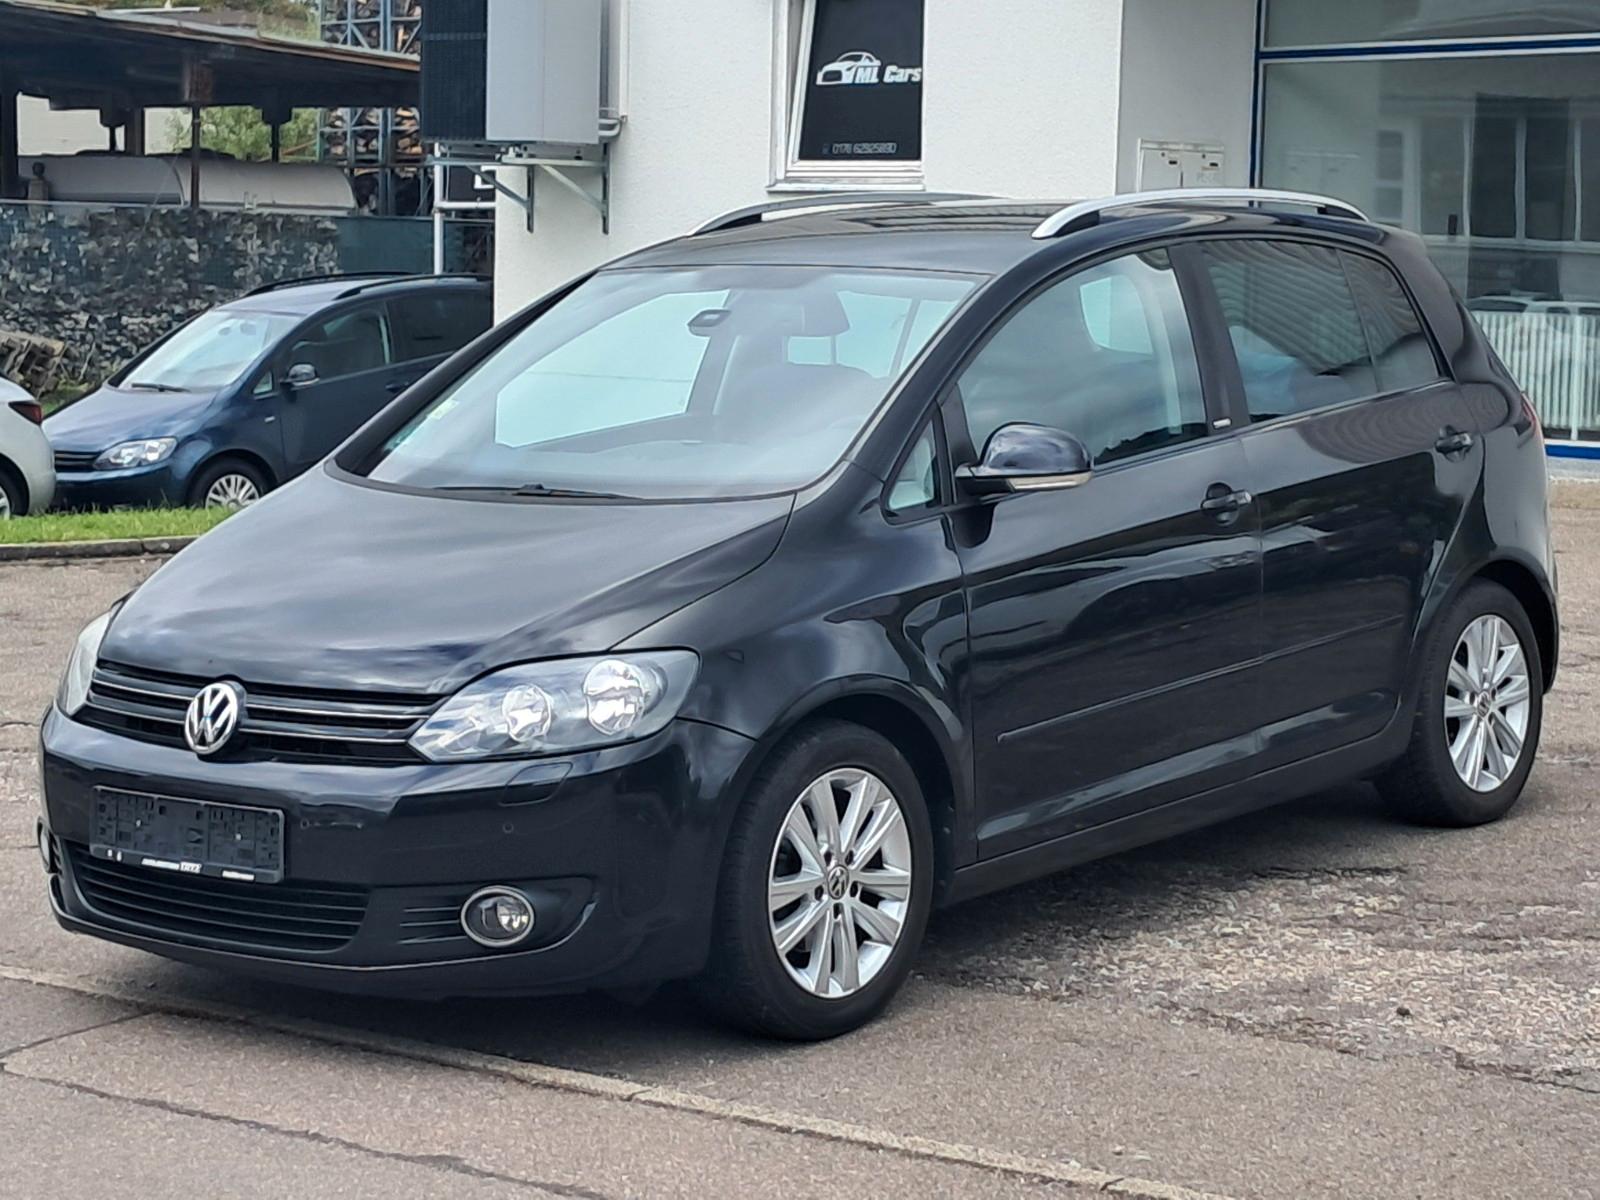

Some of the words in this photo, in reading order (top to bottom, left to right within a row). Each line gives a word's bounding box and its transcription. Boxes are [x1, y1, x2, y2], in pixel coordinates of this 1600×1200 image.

[855, 65, 880, 84] ML
[883, 65, 922, 84] Cars
[186, 683, 238, 755] VW
